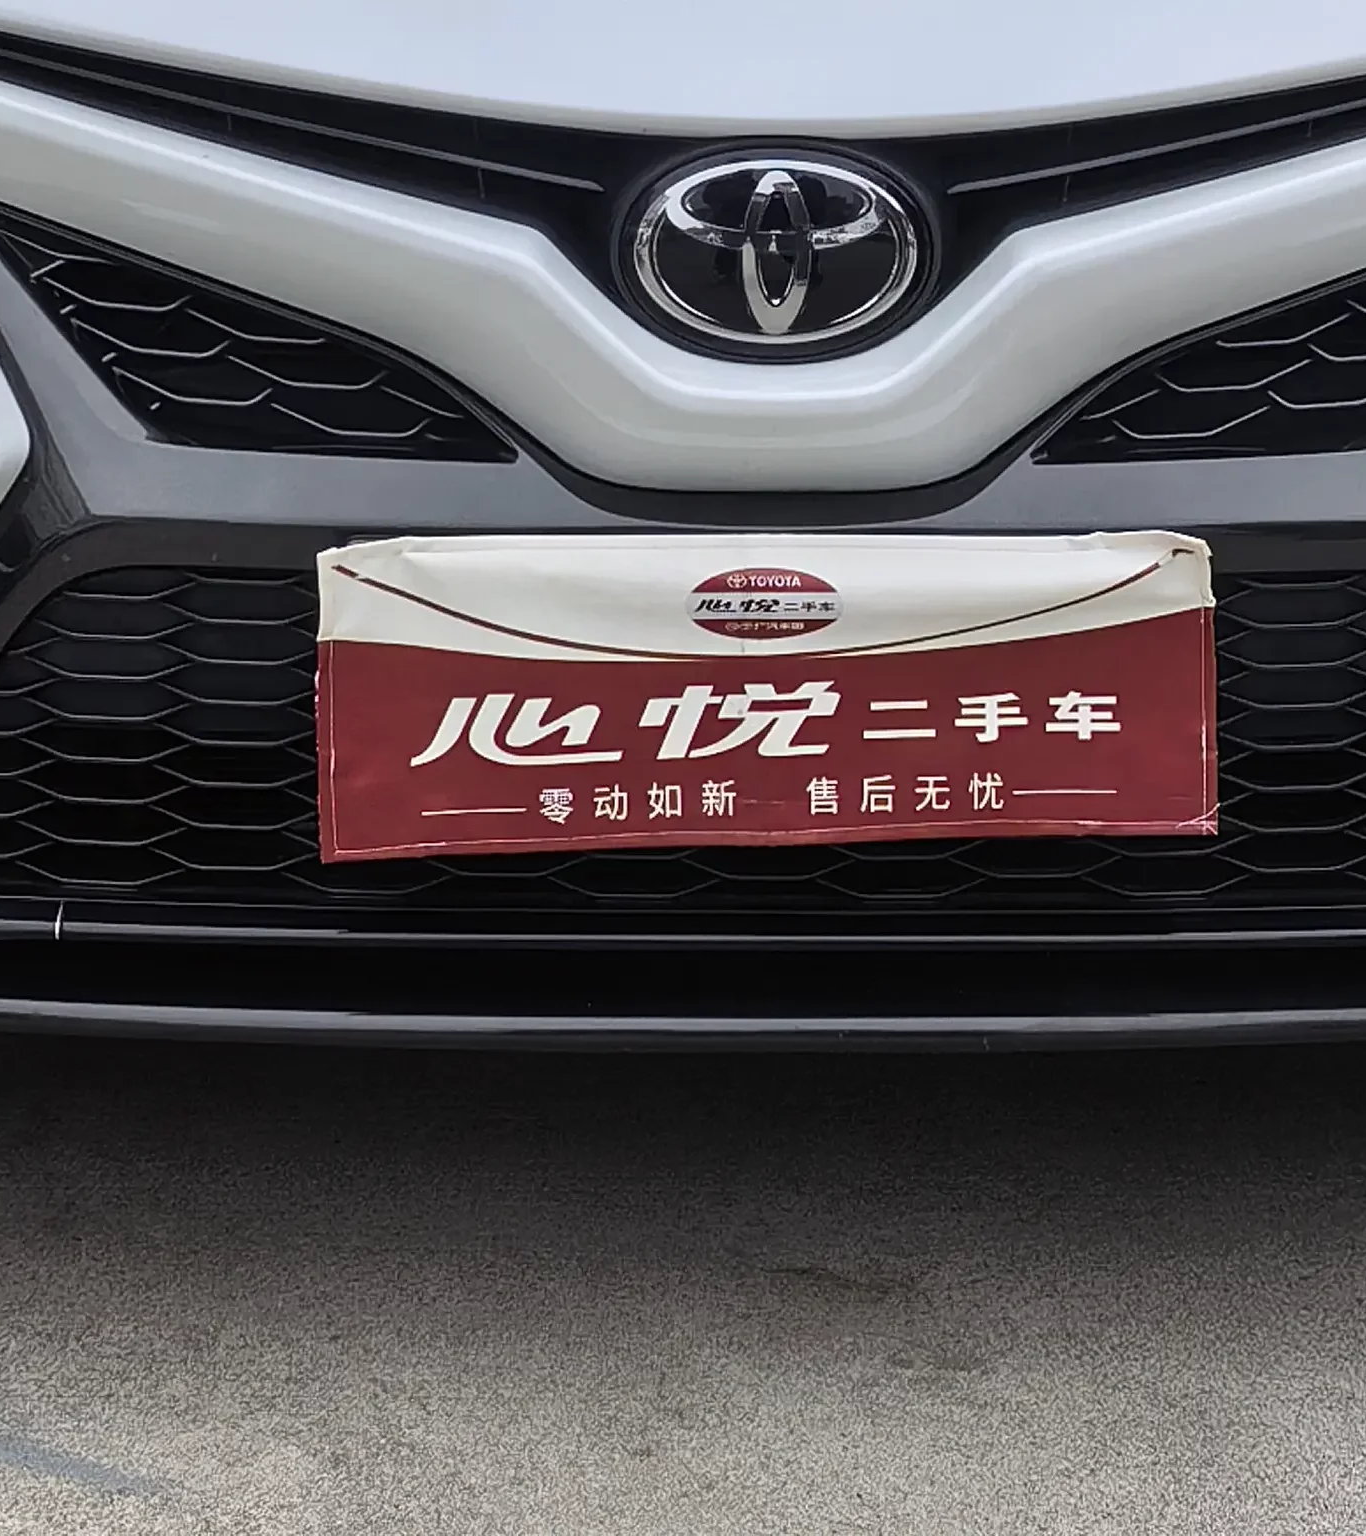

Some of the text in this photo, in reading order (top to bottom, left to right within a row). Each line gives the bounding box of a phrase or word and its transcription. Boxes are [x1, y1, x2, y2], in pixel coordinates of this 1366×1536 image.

[748, 575, 802, 587] TOYOTA
[539, 772, 1005, 824] 零动如新 售后无忧
